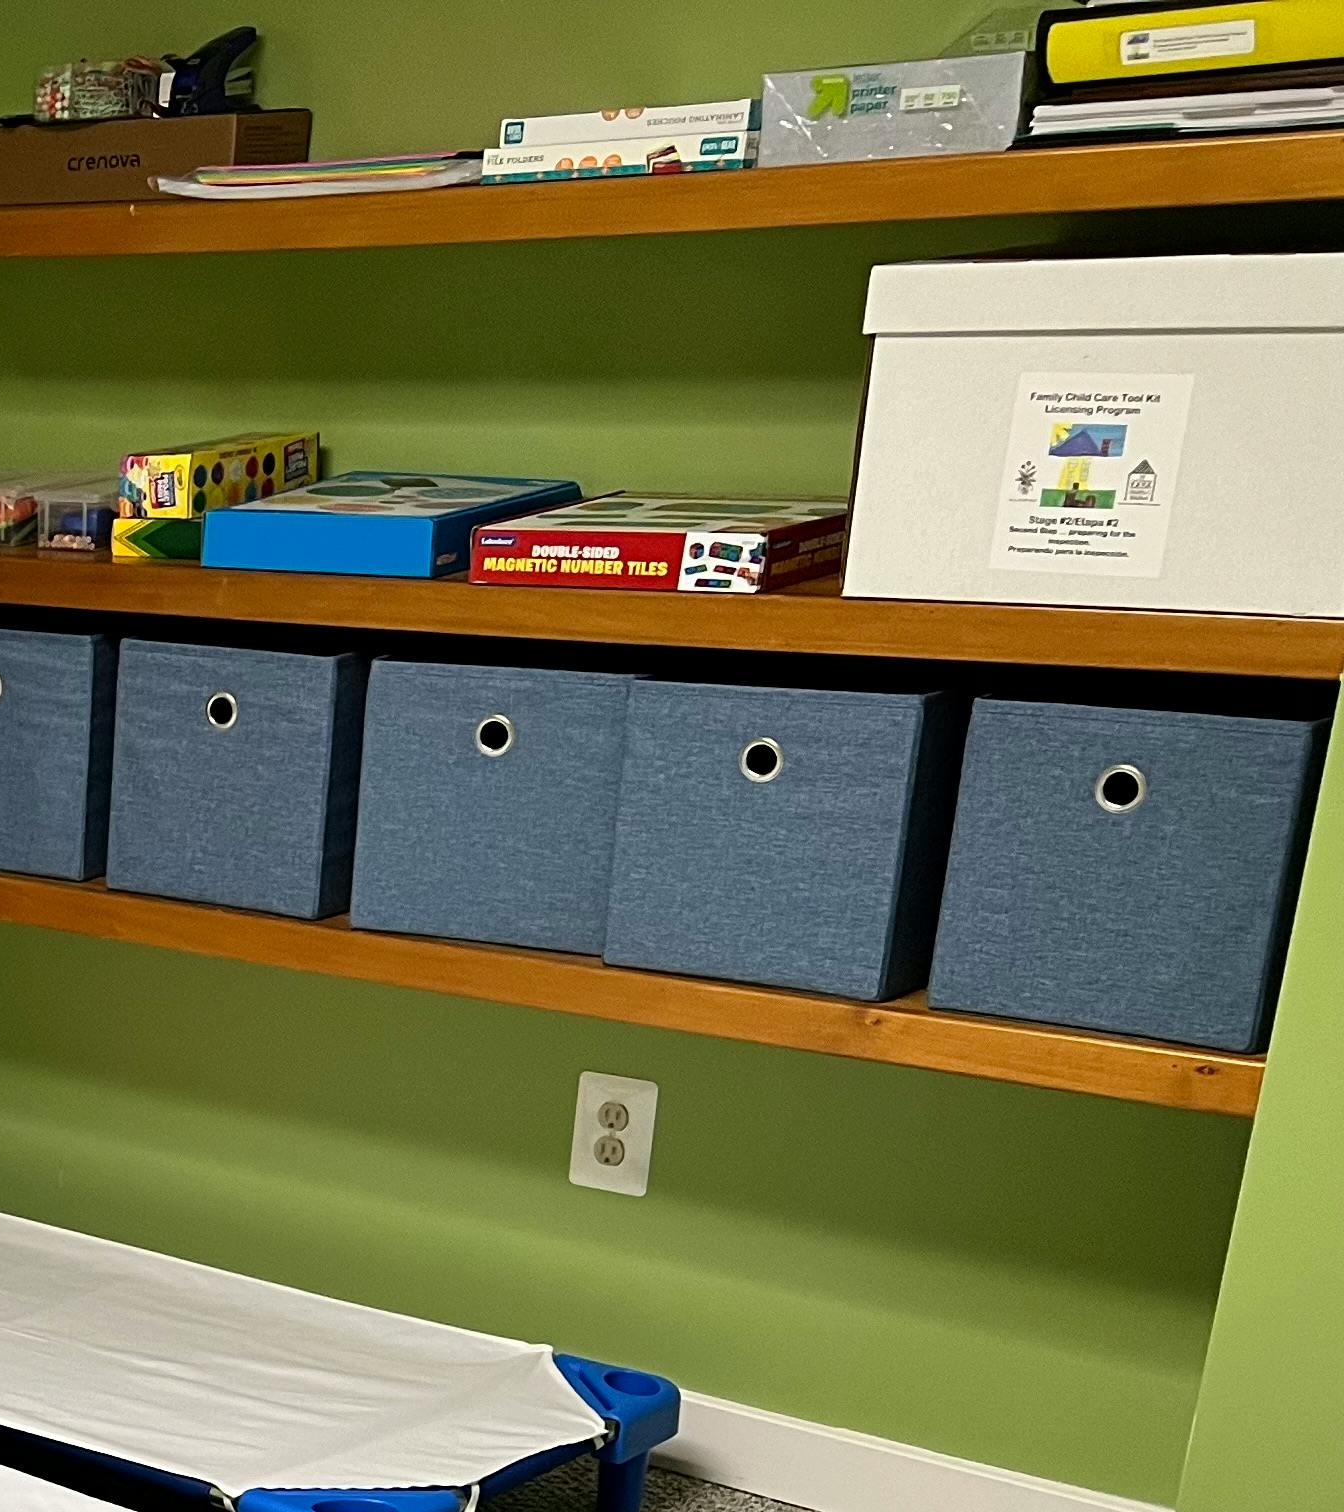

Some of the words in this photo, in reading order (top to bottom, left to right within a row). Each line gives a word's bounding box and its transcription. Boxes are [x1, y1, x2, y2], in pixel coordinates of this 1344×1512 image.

[852, 85, 898, 101] printer
[850, 101, 889, 114] paper
[67, 153, 141, 172] crenova
[506, 154, 545, 165] FOLDERS
[1030, 392, 1063, 403] Family
[1065, 392, 1092, 402] Child
[1094, 393, 1119, 402] Care
[1122, 393, 1144, 403] Tool
[1146, 394, 1161, 403] Kit
[1045, 405, 1093, 416] Licensing
[1096, 405, 1141, 416] Program
[1029, 515, 1057, 526] Stage
[1106, 518, 1119, 528] #2
[1069, 529, 1108, 538] preparing
[531, 545, 620, 560] DOUBLE-SIDED
[483, 557, 558, 574] MAGNETIC
[560, 559, 624, 575] NUMBER
[627, 560, 669, 577] TILES
